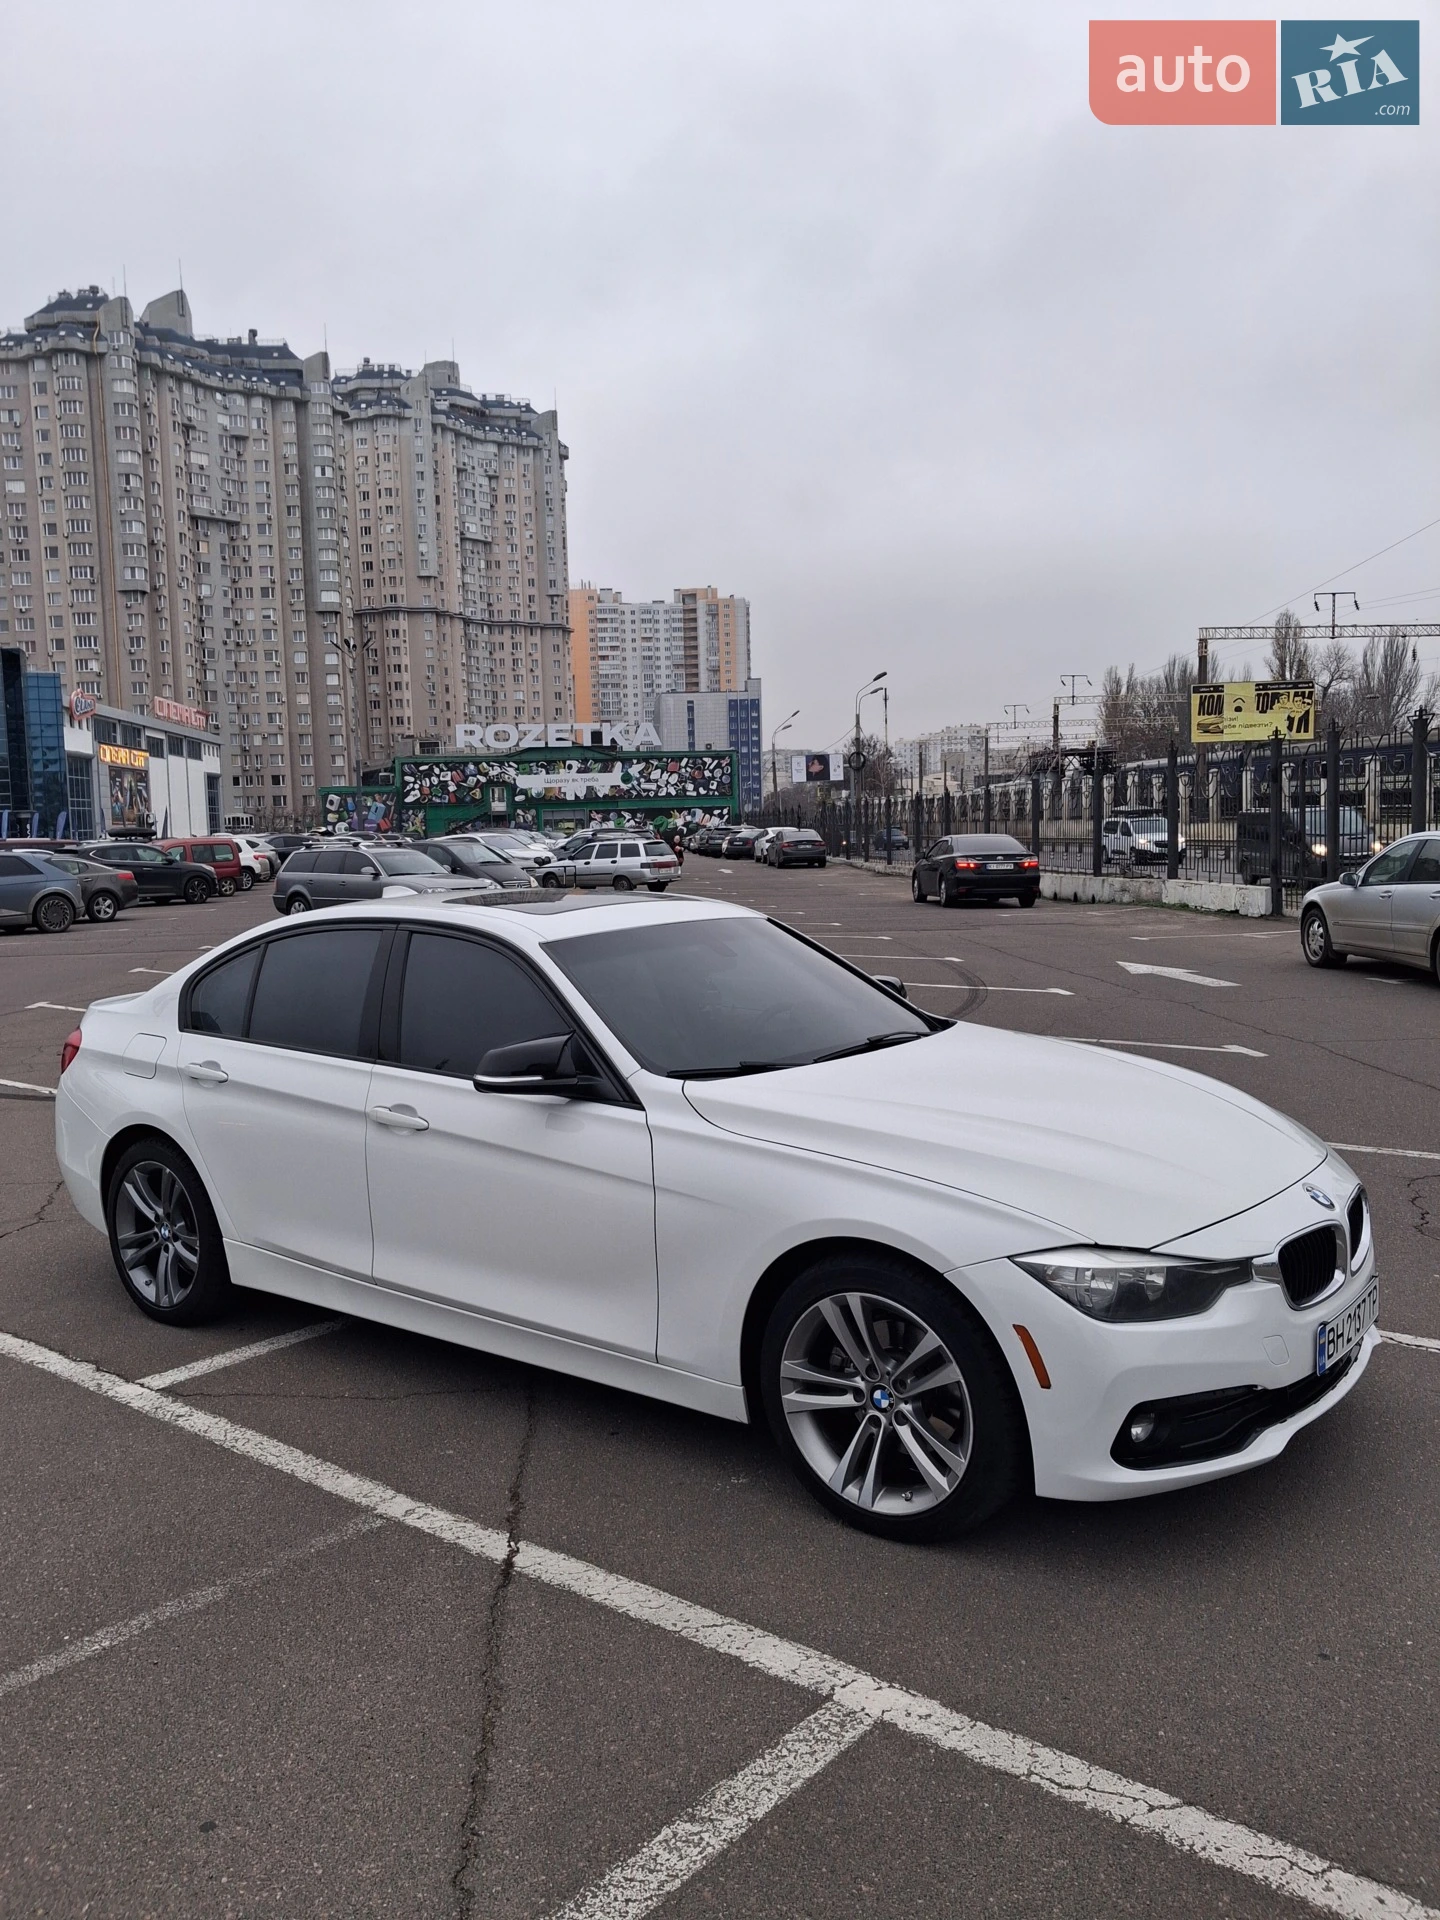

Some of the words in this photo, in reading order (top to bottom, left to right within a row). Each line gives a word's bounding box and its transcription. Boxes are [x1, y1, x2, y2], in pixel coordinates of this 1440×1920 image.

[456, 723, 662, 748] ROZETKA
[1327, 1317, 1345, 1361] BH
[1346, 1298, 1366, 1345] 2137
[1367, 1284, 1378, 1319] TP
